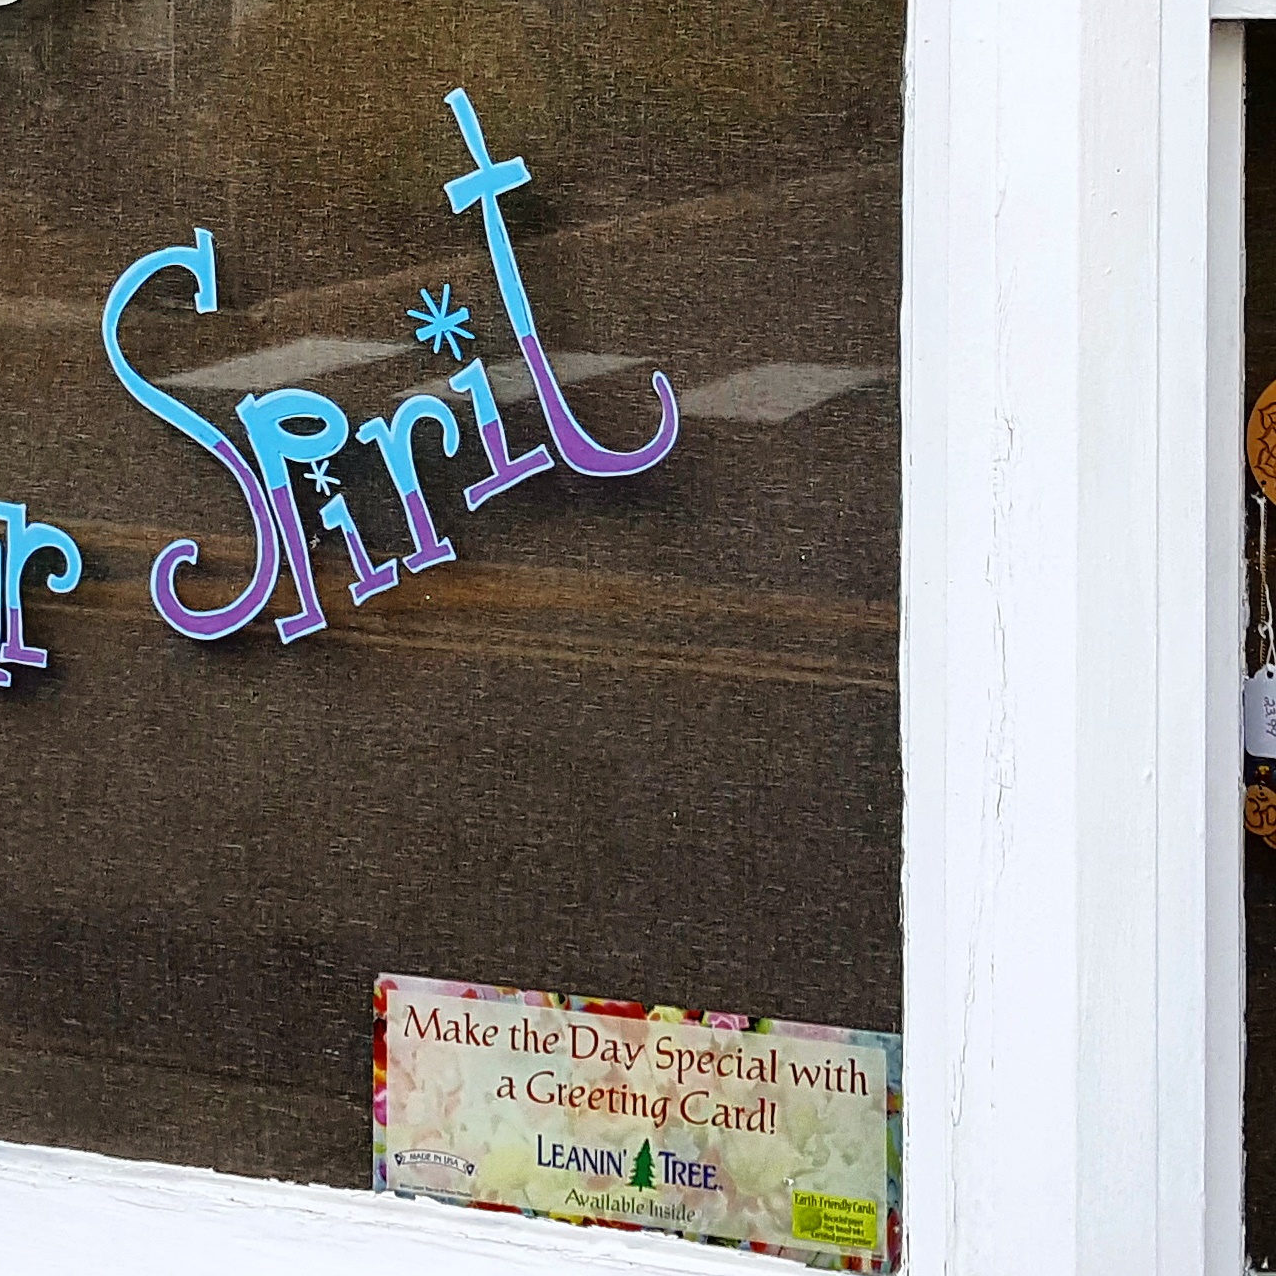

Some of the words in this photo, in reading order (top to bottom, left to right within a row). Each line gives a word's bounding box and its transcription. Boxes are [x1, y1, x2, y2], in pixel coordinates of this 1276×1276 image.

[101, 87, 679, 645] Spirit
[404, 1005, 499, 1048] Make
[508, 1018, 559, 1055] the
[569, 1024, 645, 1070] Day
[655, 1036, 778, 1084] Special
[788, 1058, 869, 1097] with
[496, 1076, 518, 1101] a
[526, 1071, 671, 1128] Greeting
[680, 1091, 778, 1135] Card!
[409, 1152, 432, 1162] MADE
[433, 1154, 443, 1164] IN
[443, 1155, 459, 1168] USA
[537, 1133, 627, 1178] LEANIN'
[565, 1188, 643, 1217] Available
[648, 1198, 696, 1224] Inside
[852, 1201, 875, 1216] Cards
